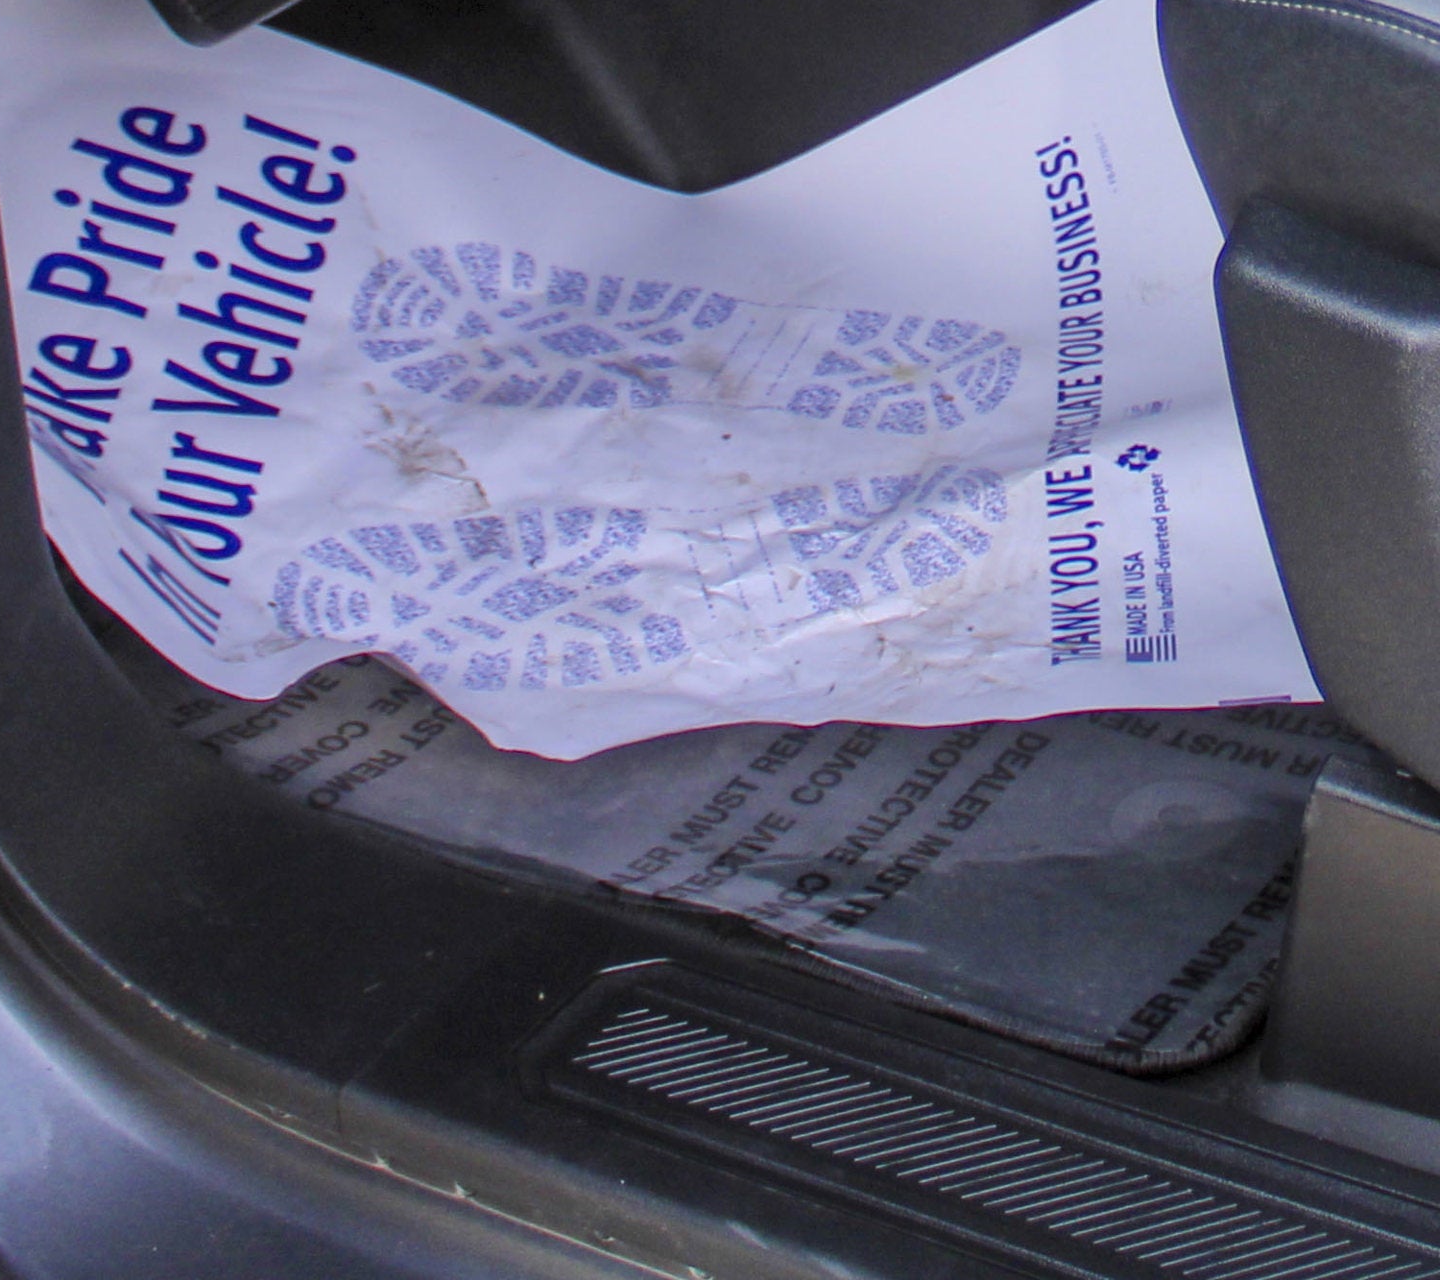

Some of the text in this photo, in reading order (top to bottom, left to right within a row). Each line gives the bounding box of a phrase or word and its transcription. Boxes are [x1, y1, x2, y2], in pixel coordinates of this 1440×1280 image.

[27, 105, 208, 319] Pride
[1035, 134, 1104, 312] BUSINESS!
[150, 113, 358, 418] Vehicle!
[1058, 308, 1104, 379] YOUR
[1044, 465, 1095, 520] WE
[1048, 520, 1105, 596] YOU,
[1149, 472, 1176, 633] From landfill-diverted paper
[1122, 550, 1148, 636] MADE IN USA
[1049, 597, 1103, 667] THANK
[399, 703, 459, 752] UST
[669, 774, 760, 847] MUST
[937, 730, 1052, 831] DEALER
[1169, 921, 1257, 992] MUST
